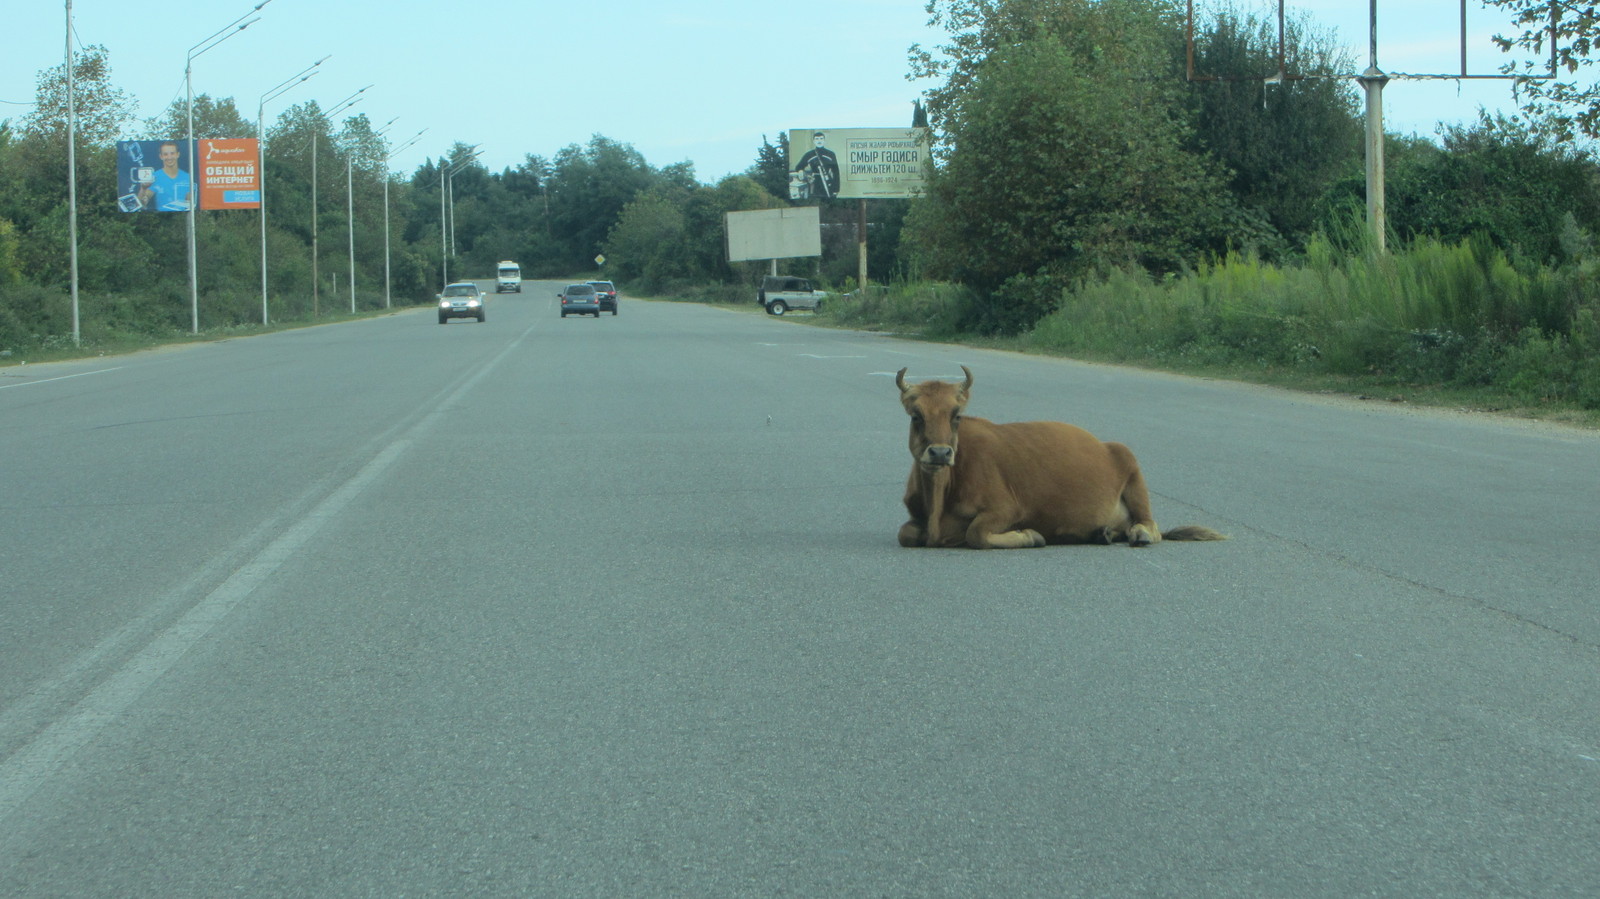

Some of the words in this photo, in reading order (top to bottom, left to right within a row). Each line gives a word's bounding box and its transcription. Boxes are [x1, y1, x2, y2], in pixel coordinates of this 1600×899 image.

[850, 150, 878, 162] СМЫР
[206, 164, 254, 176] ОБЩИЙ
[893, 164, 906, 174] 120
[206, 176, 254, 184] ИНТЕРНЕТ
